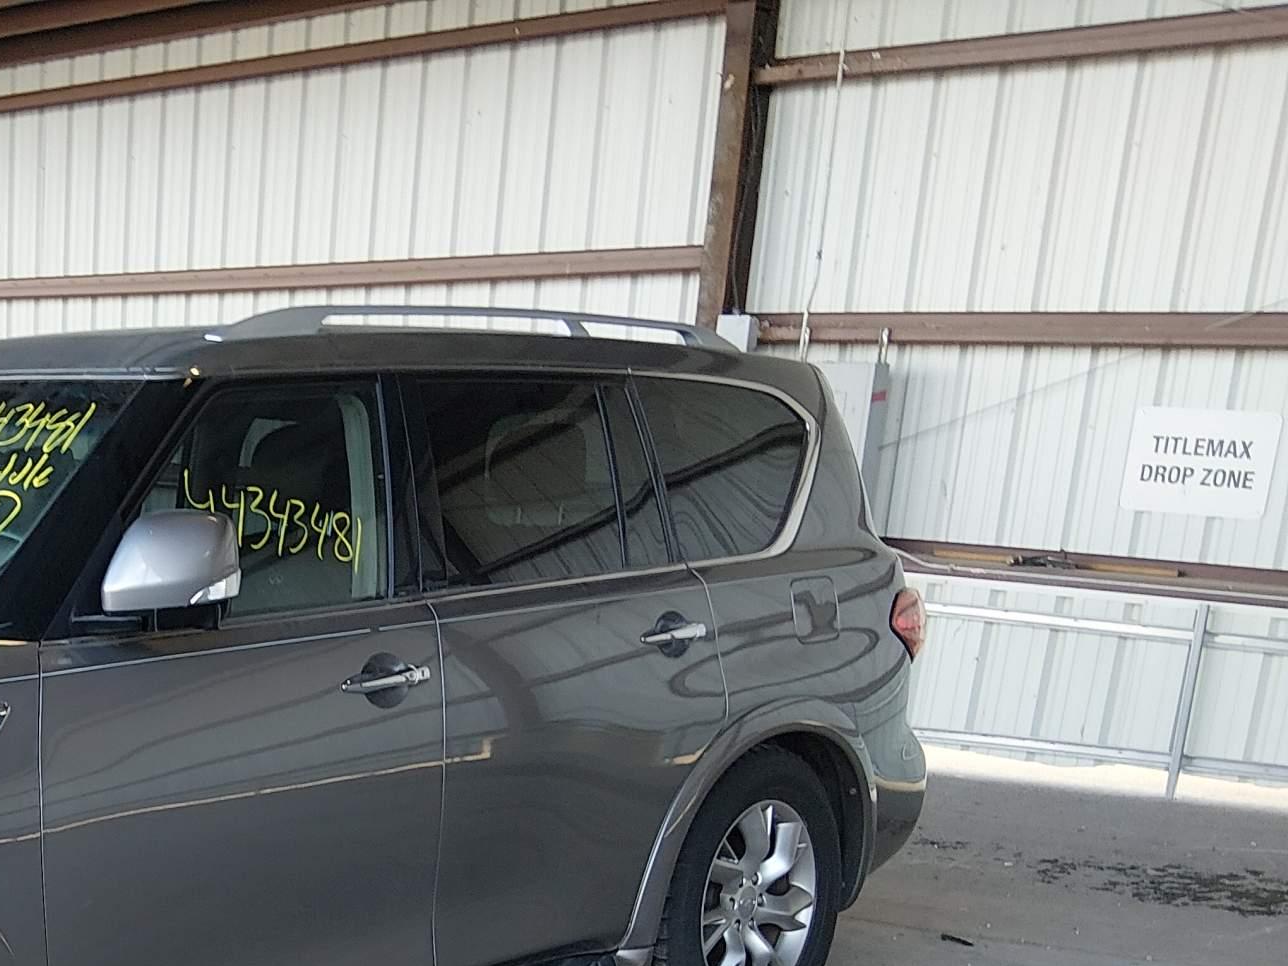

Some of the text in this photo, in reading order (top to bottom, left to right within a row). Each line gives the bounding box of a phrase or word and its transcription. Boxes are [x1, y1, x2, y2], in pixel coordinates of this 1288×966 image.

[1153, 435, 1253, 460] TITLEMAX
[1140, 464, 1255, 490] DROP ZONE
[183, 468, 362, 575] 44343481
